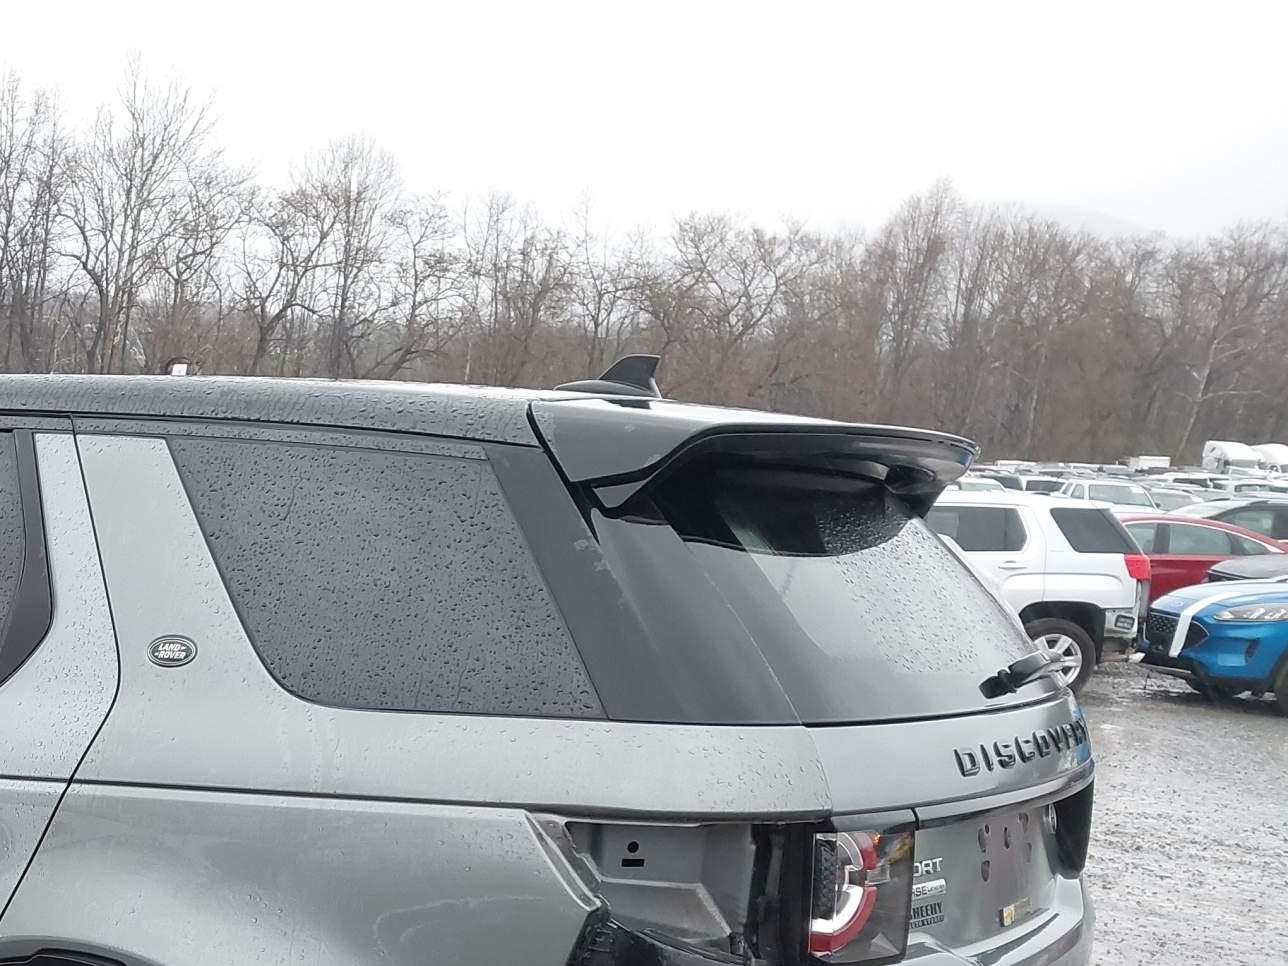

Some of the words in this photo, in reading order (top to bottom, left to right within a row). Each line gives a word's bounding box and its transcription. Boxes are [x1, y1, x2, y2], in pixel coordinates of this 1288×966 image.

[158, 643, 182, 651] LAND
[158, 650, 186, 659] ROVER
[912, 857, 943, 877] ORT
[911, 901, 943, 919] HEEHY
